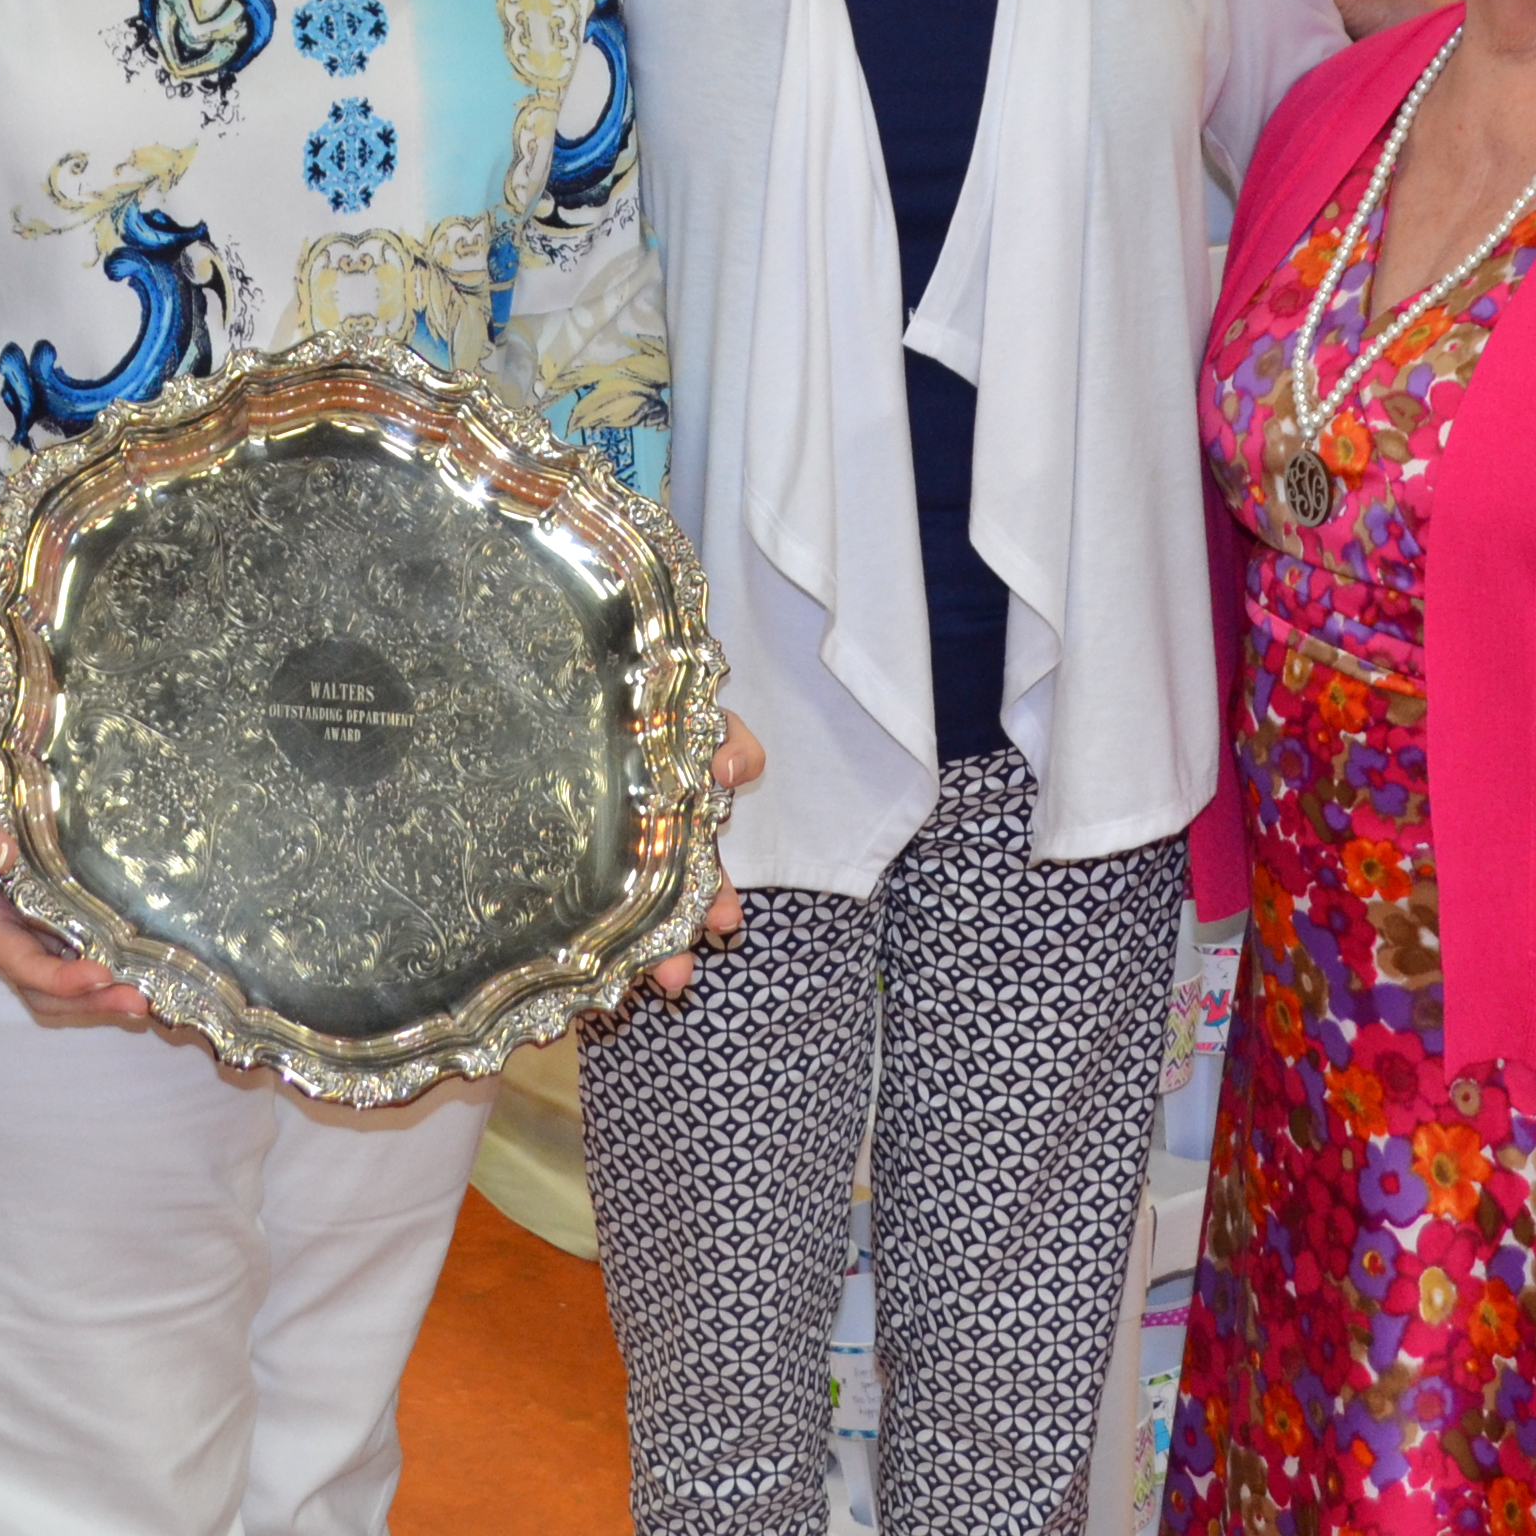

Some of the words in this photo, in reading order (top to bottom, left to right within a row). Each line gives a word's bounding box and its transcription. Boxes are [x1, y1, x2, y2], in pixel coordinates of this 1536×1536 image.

[309, 680, 376, 703] WALTERS
[268, 703, 344, 724] OUTSTANDING
[345, 709, 415, 728] DEPARTMENT
[323, 726, 362, 743] AWARD
